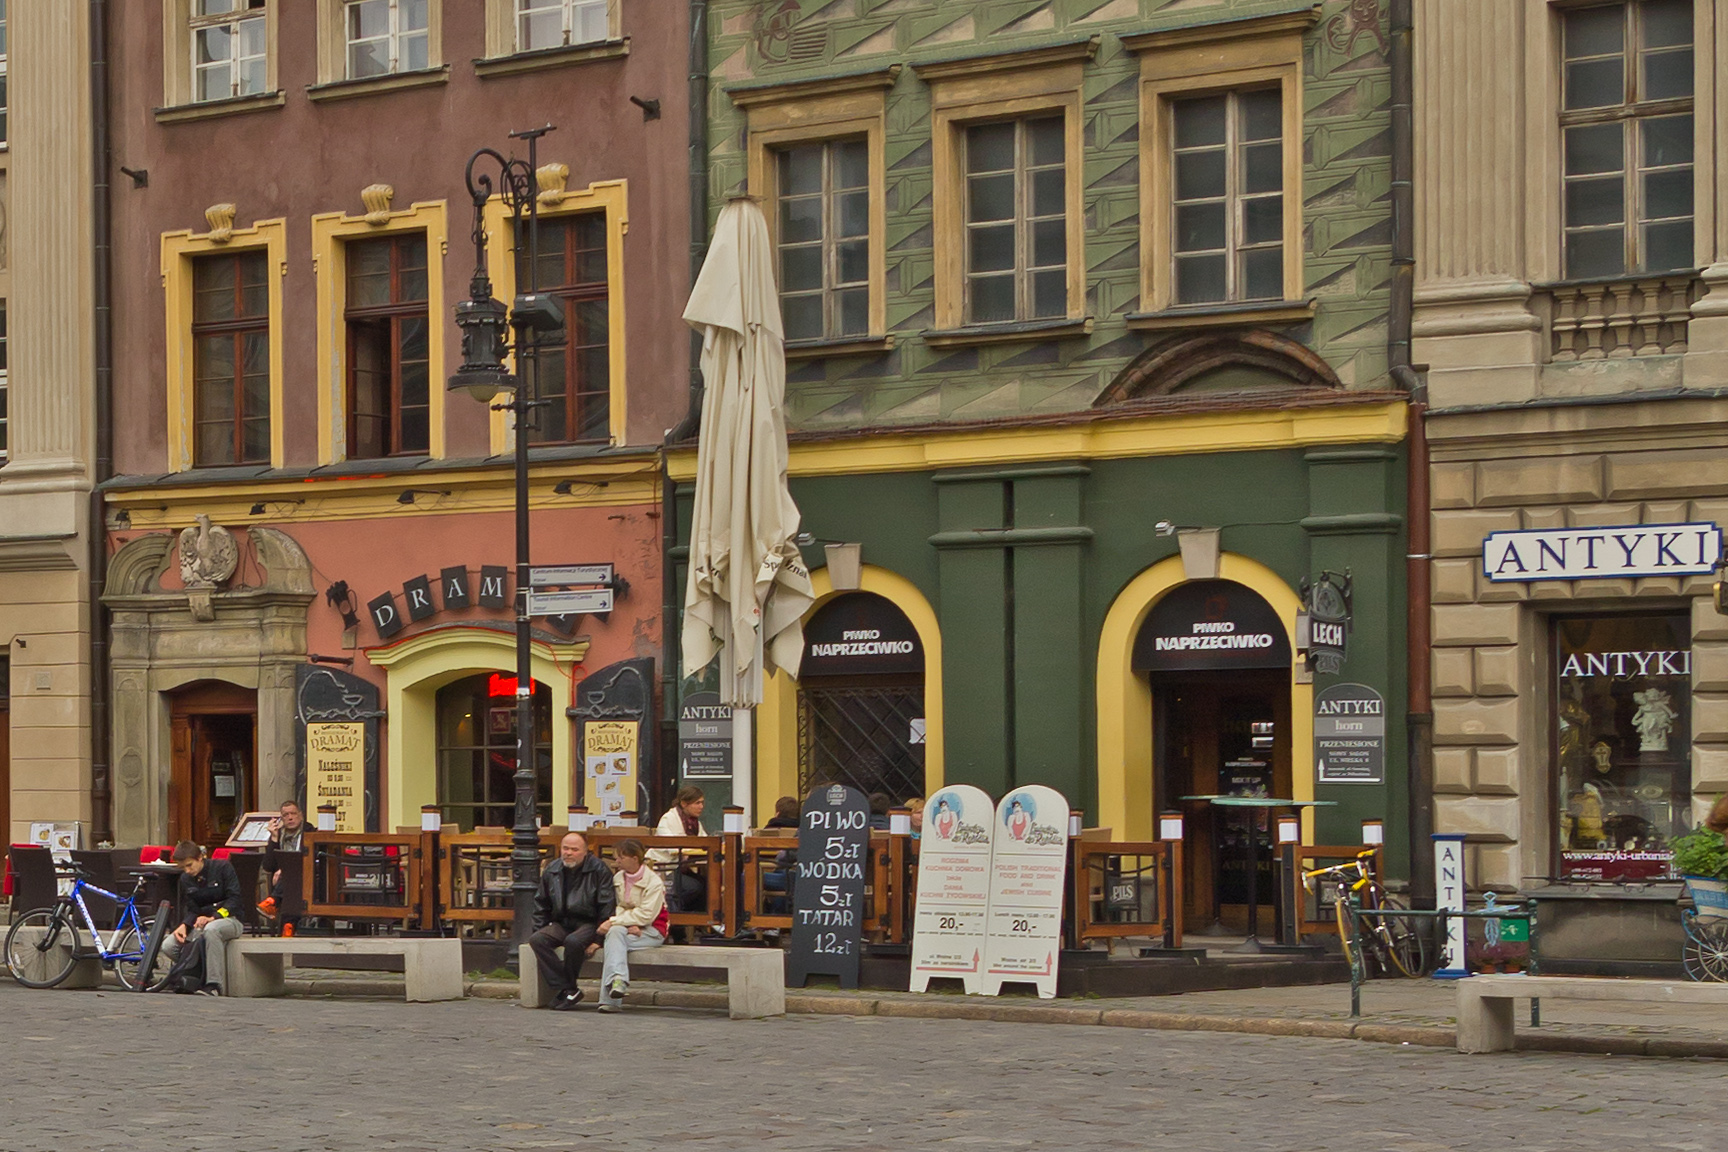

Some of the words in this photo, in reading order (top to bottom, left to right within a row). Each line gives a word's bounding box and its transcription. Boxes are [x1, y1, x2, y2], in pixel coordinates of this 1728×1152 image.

[1494, 531, 1709, 574] ANTYKI
[375, 576, 567, 628] DRAM
[842, 630, 880, 640] PIWKO
[1193, 621, 1234, 634] PIWKO
[1313, 622, 1343, 646] LECH
[812, 641, 914, 656] NAPRZECIWKO
[1155, 634, 1273, 651] NAPRZECIWKO
[1560, 651, 1691, 677] ANTYKI
[681, 706, 732, 719] ANTYKI
[1318, 700, 1380, 714] ANTYKI
[696, 724, 718, 733] horn
[1335, 720, 1363, 730] horn
[310, 735, 360, 749] DRAMAT
[588, 734, 634, 749] DRAMAT
[805, 811, 867, 830] PIWO
[798, 857, 863, 880] WÓDKA
[1113, 885, 1133, 899] PILS
[798, 909, 854, 927] TATAR
[939, 917, 964, 931] 20,-
[1012, 919, 1037, 934] 20,-
